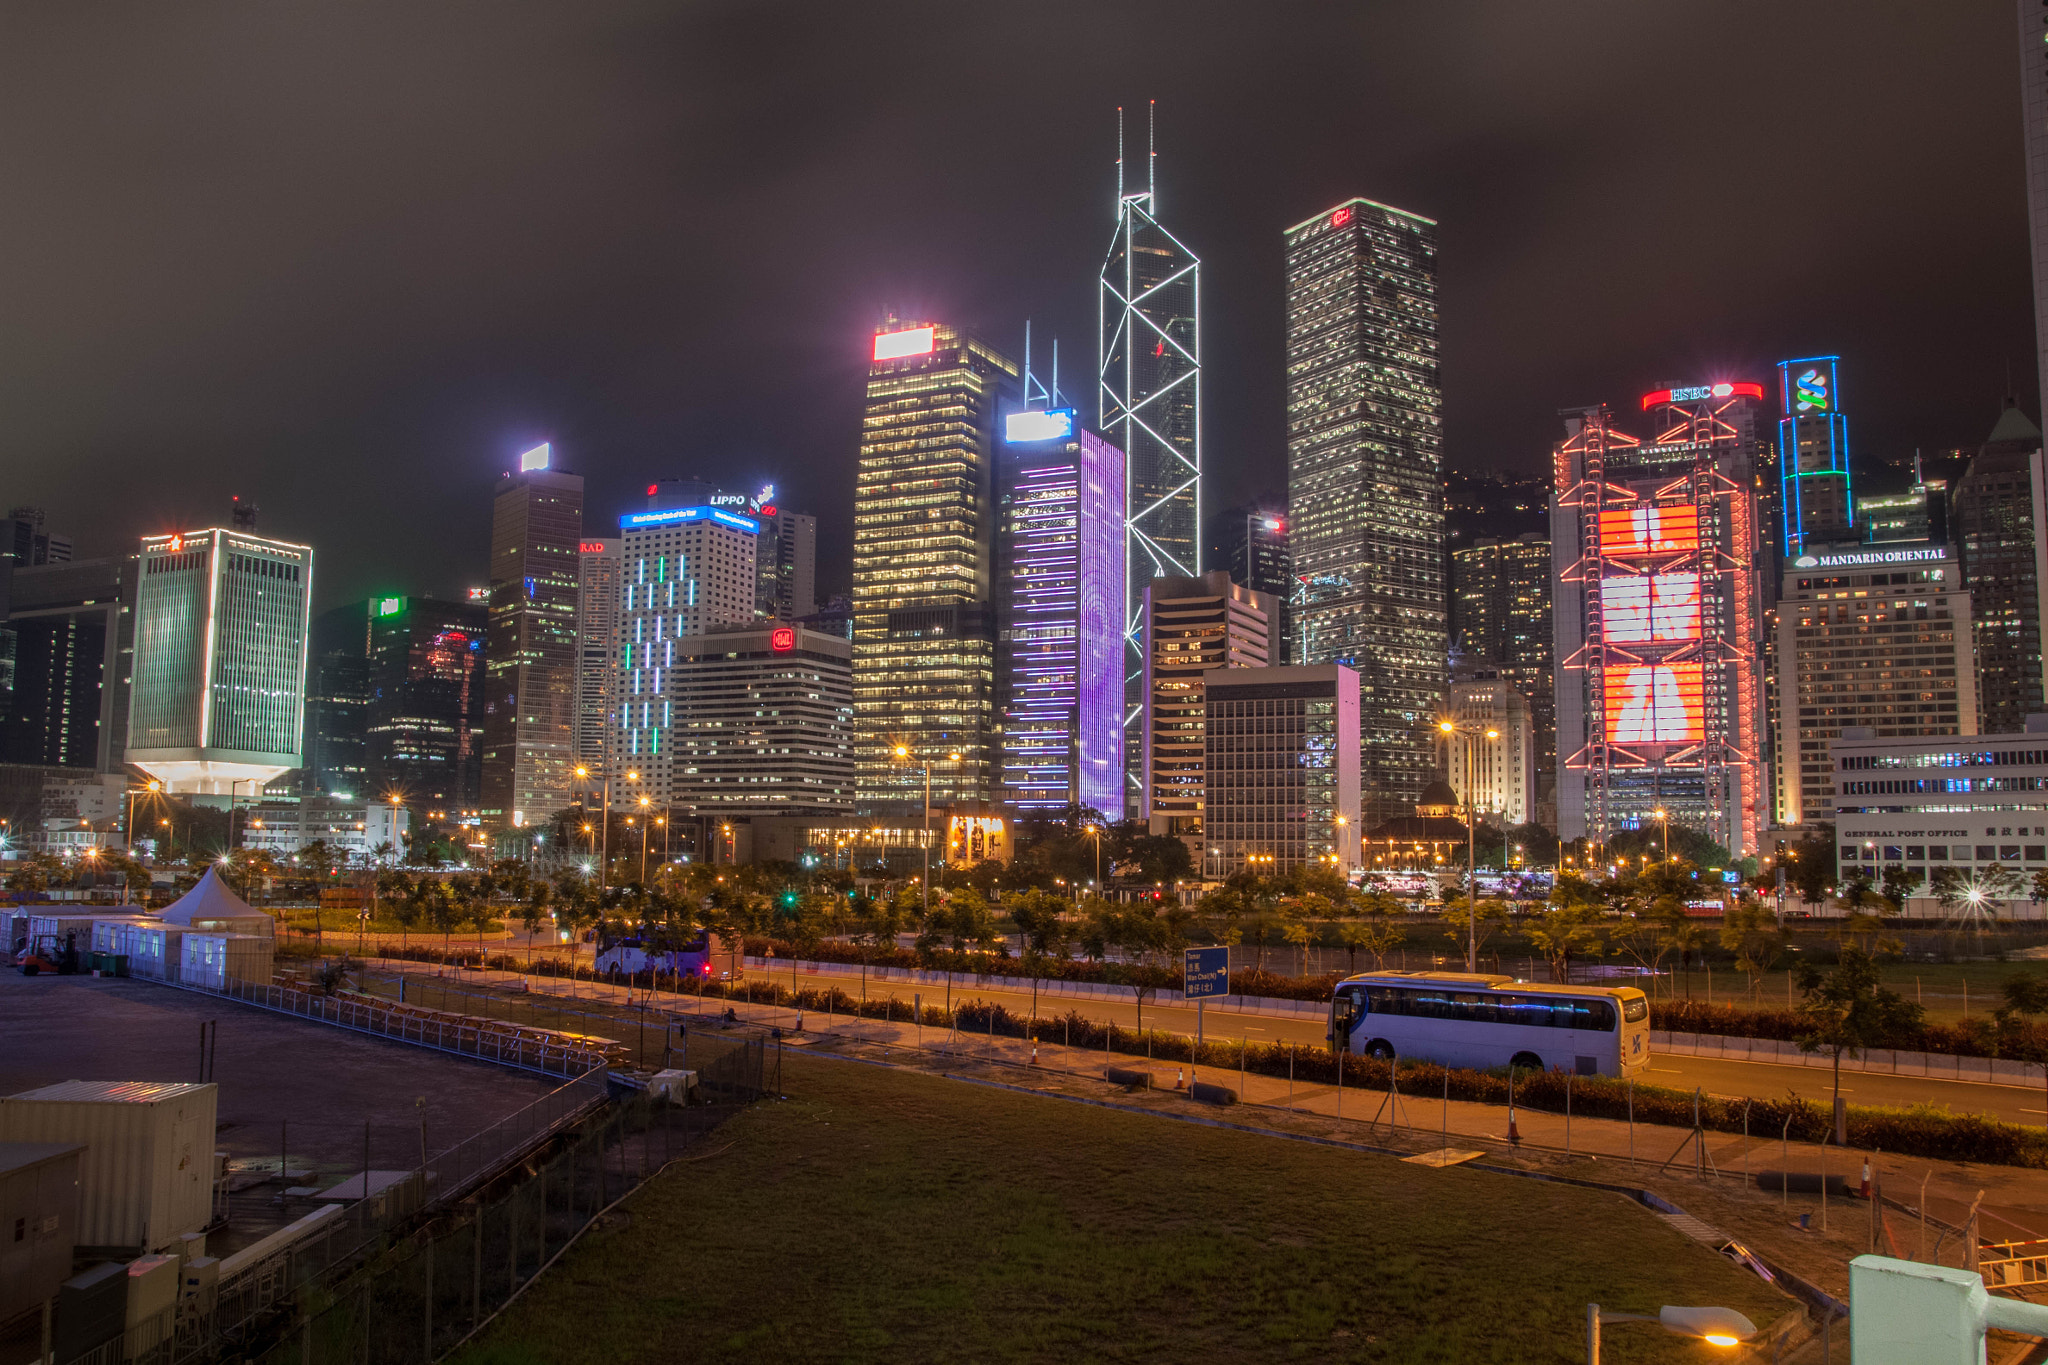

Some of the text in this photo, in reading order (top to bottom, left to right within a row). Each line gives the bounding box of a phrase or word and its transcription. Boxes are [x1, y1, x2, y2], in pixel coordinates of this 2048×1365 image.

[1670, 386, 1711, 402] HSBC
[710, 495, 745, 505] LIPPO
[1819, 549, 1946, 566] MANDARIN ORIENTAL
[1844, 829, 1968, 838] GENERAL POST OFFICE
